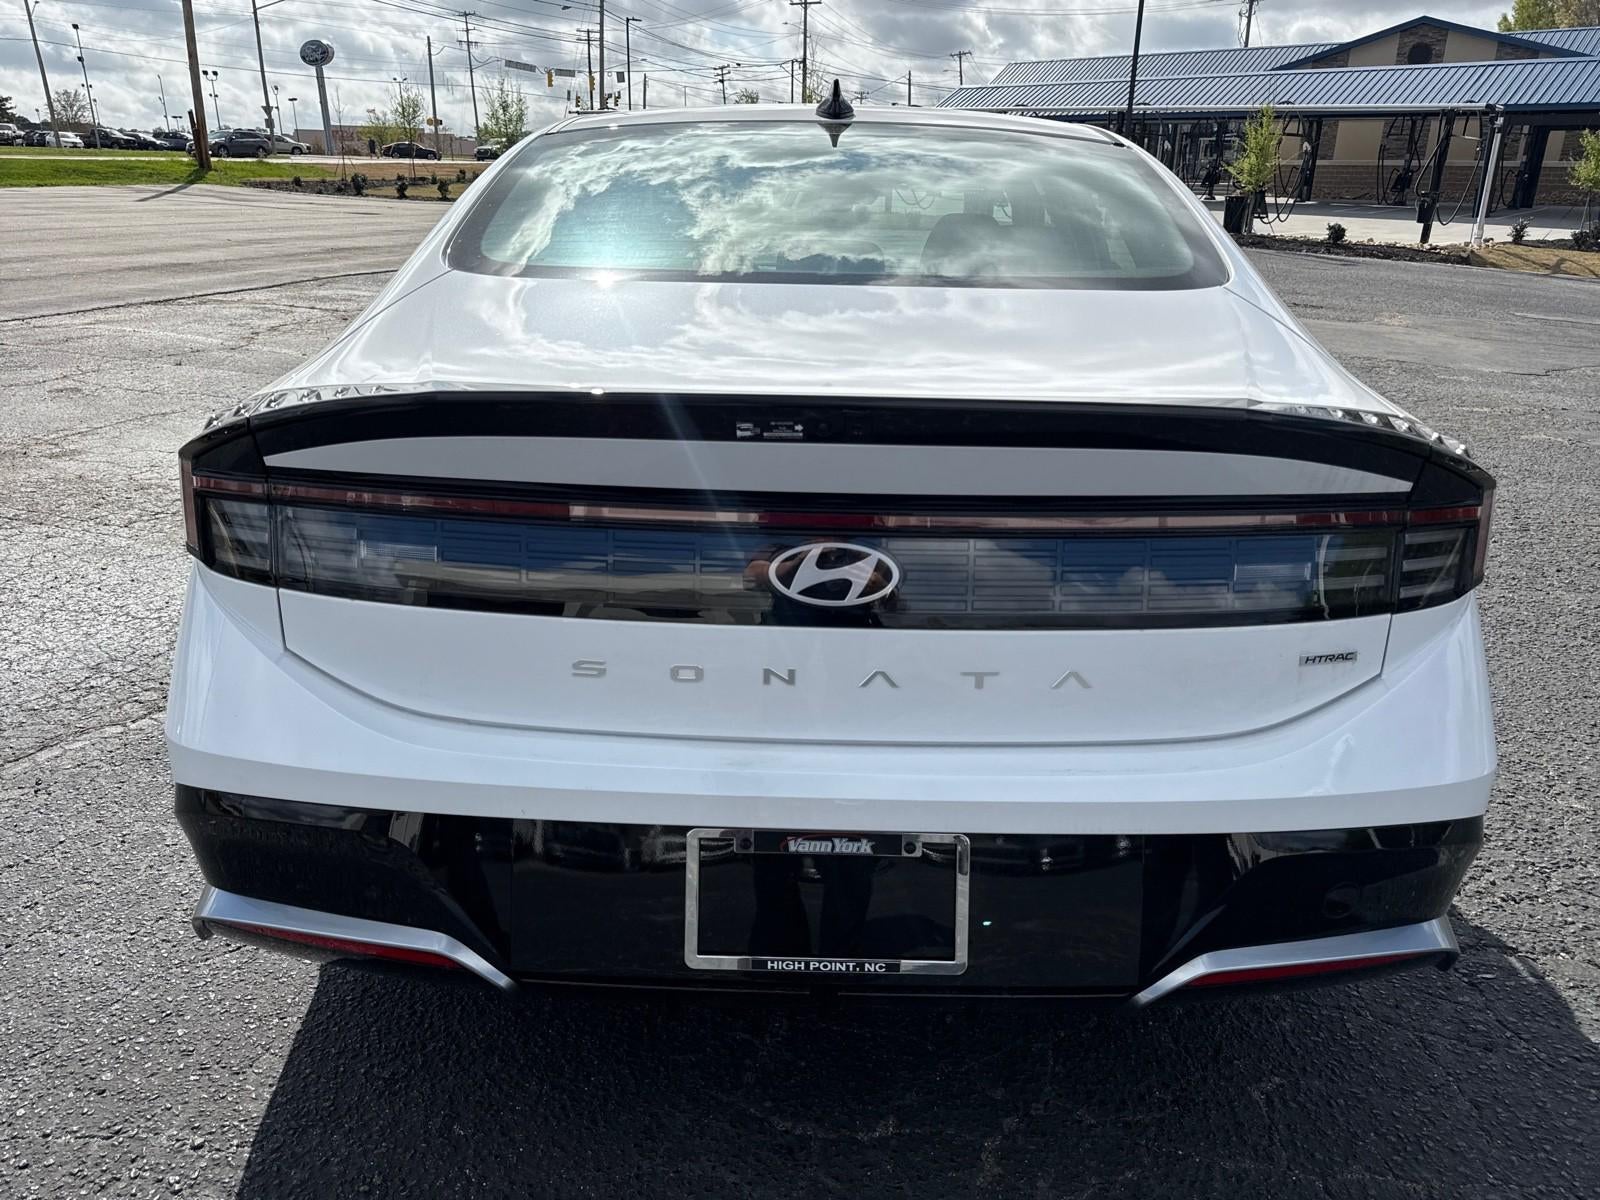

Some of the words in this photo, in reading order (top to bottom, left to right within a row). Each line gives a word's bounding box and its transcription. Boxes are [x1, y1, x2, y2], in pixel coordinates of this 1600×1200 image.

[1304, 652, 1356, 664] HTRAC
[571, 659, 1094, 689] SONATA
[767, 960, 805, 970] HIGH
[864, 962, 886, 972] NC
